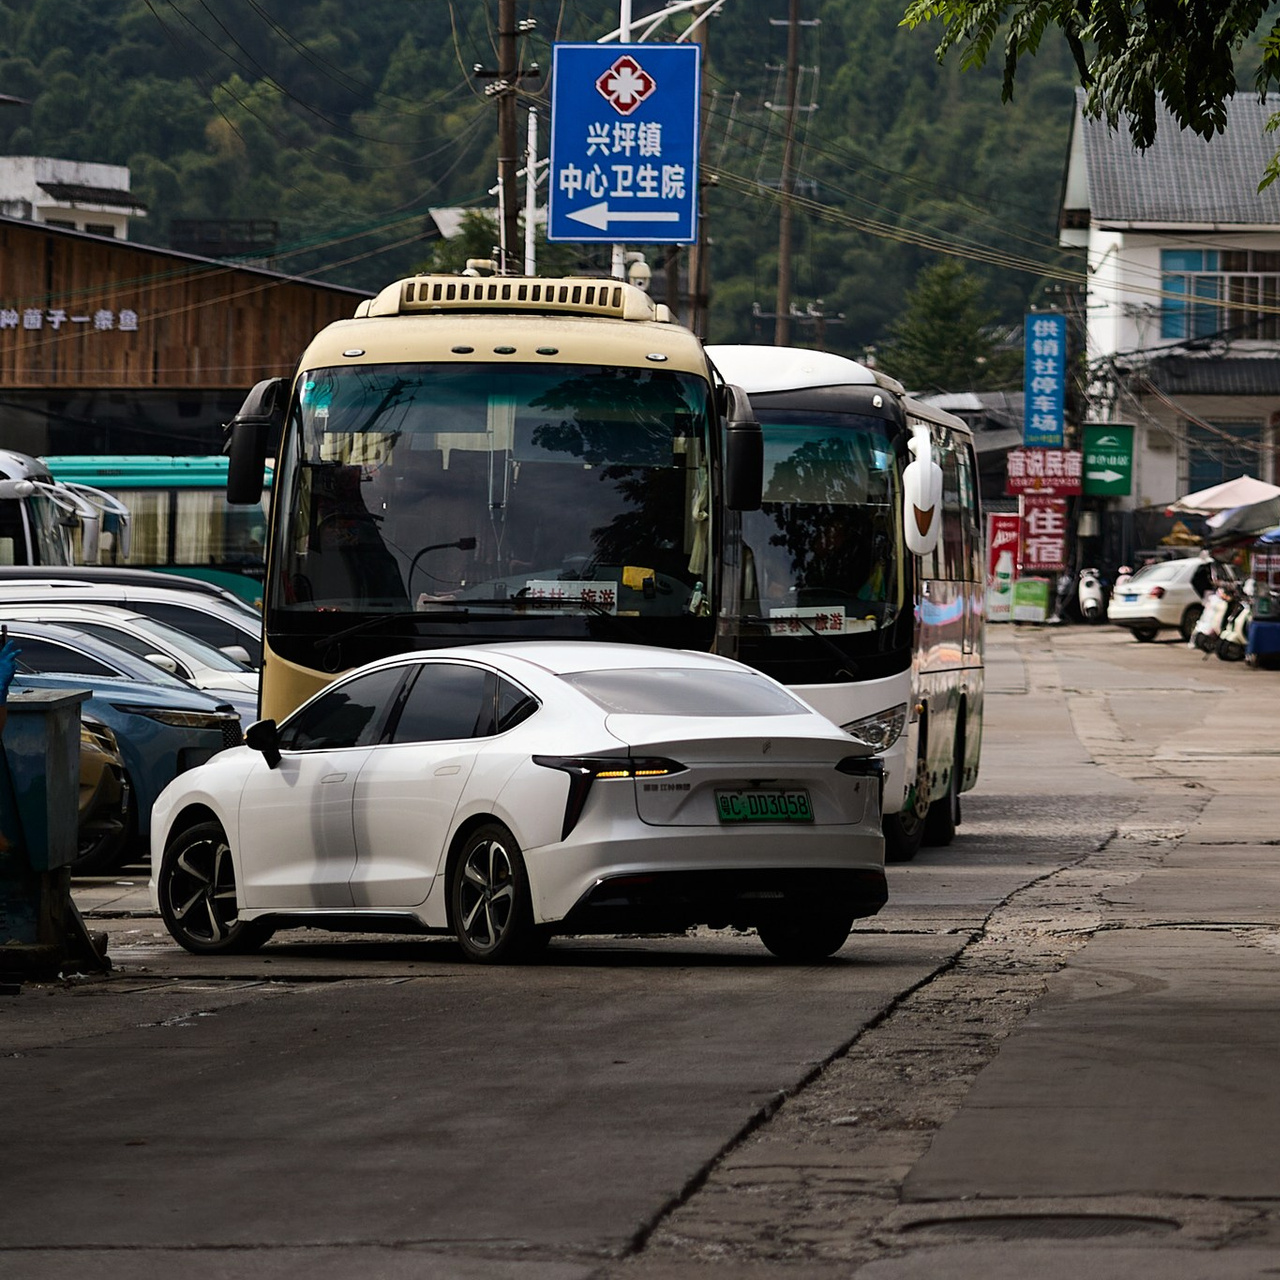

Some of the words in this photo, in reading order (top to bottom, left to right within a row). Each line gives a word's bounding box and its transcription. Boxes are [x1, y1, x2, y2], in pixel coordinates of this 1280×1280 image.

[586, 121, 662, 157] 兴坪镇
[559, 163, 686, 199] 中心卫生院
[1031, 320, 1060, 432] 供销社停车场
[1025, 507, 1065, 563] 住宿
[750, 794, 809, 815] DD3058
